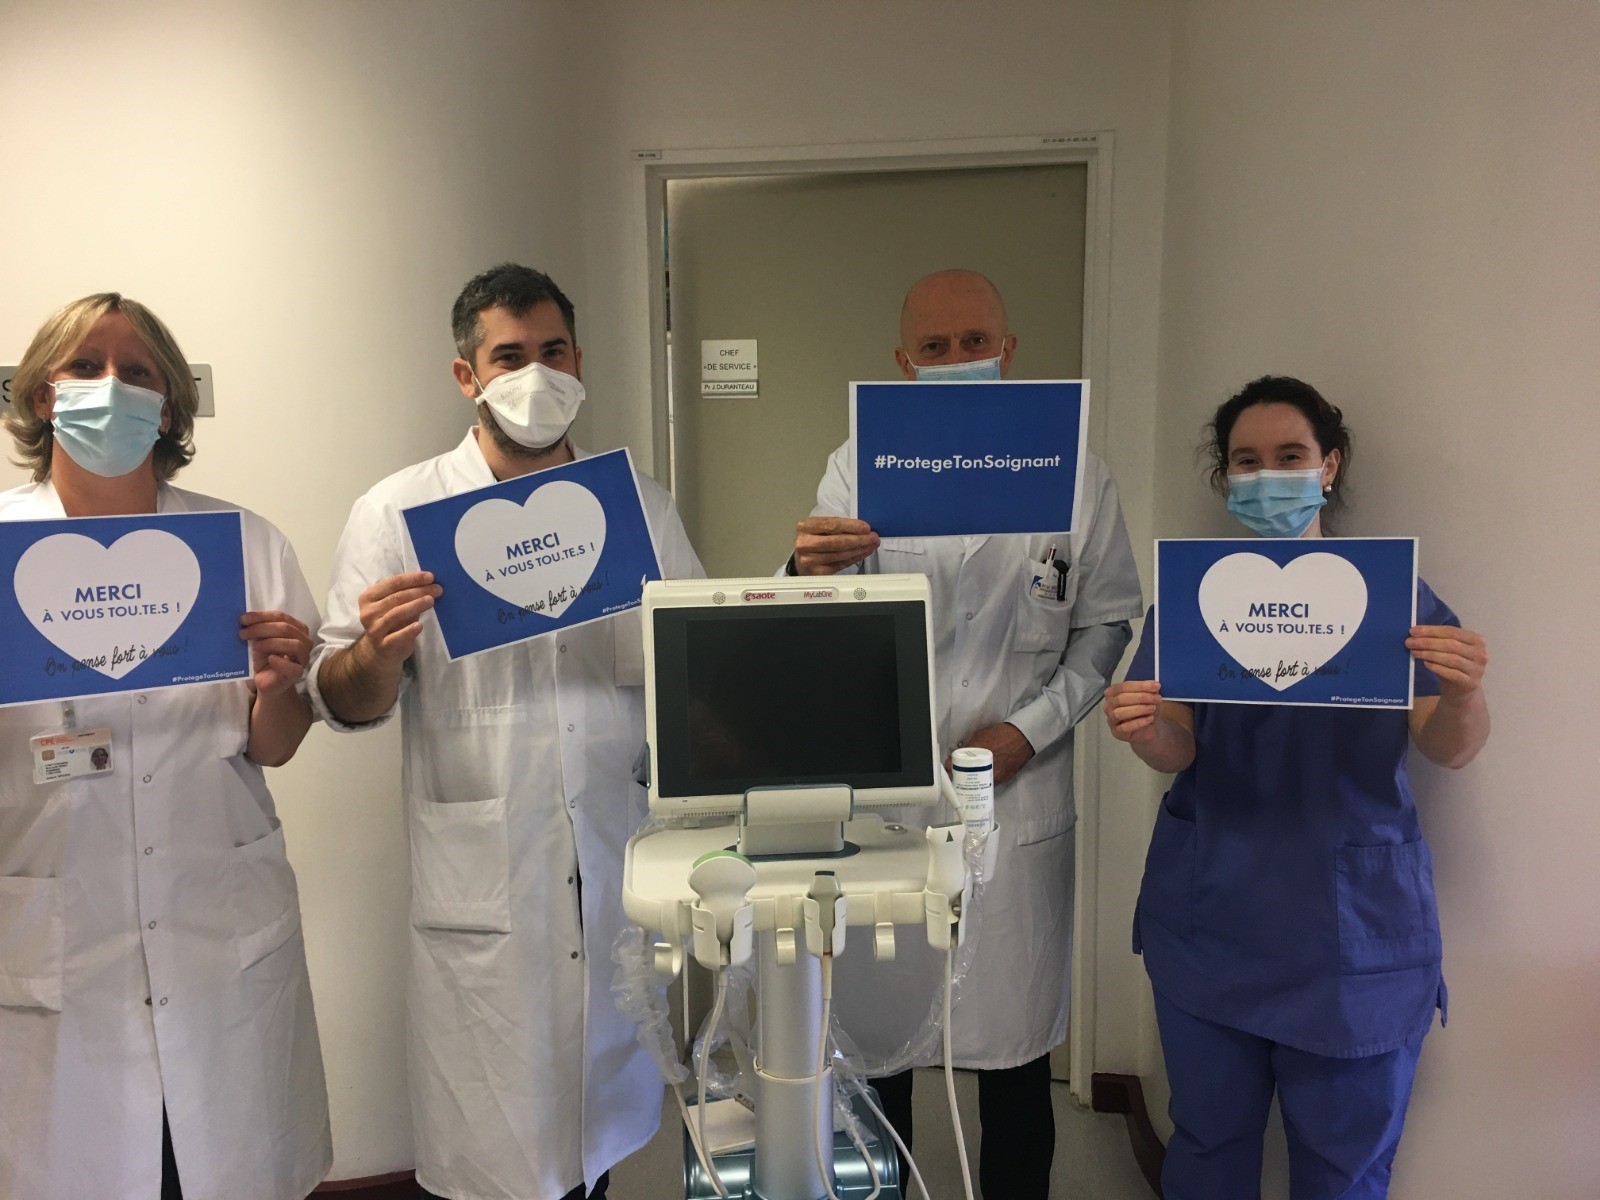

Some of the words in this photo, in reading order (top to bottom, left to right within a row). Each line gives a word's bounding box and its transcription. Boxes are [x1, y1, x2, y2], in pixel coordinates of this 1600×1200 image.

[874, 454, 1061, 473] #ProtegeTonSoignant
[506, 532, 560, 559] MERCI
[485, 569, 495, 582] À
[499, 560, 534, 577] VOUS
[535, 544, 586, 567] TOU.TE.S
[75, 584, 141, 603] MERCI
[804, 591, 832, 599] MyLabOne
[42, 608, 53, 623] À
[61, 607, 104, 621] VOUS
[108, 602, 169, 617] TOU.TE.S
[497, 608, 515, 624] On
[519, 600, 546, 623] pense
[549, 586, 568, 611] fort
[570, 585, 578, 598] à
[603, 598, 642, 613] #ProtegeTonS
[1248, 603, 1309, 618] MERCI
[1219, 619, 1229, 632] À
[1235, 623, 1273, 633] VOUS
[1277, 623, 1333, 634] TOU.TE.S
[44, 656, 67, 676] On
[71, 655, 106, 677] pense
[111, 645, 136, 671] fort
[139, 645, 147, 659] à
[172, 670, 245, 682] #ProtegeTonSoignant
[1217, 663, 1236, 680] On
[1240, 667, 1271, 683] pense
[1275, 660, 1299, 682] fort
[1302, 662, 1310, 676] à
[1331, 696, 1404, 704] #ProtegeTonSoignant
